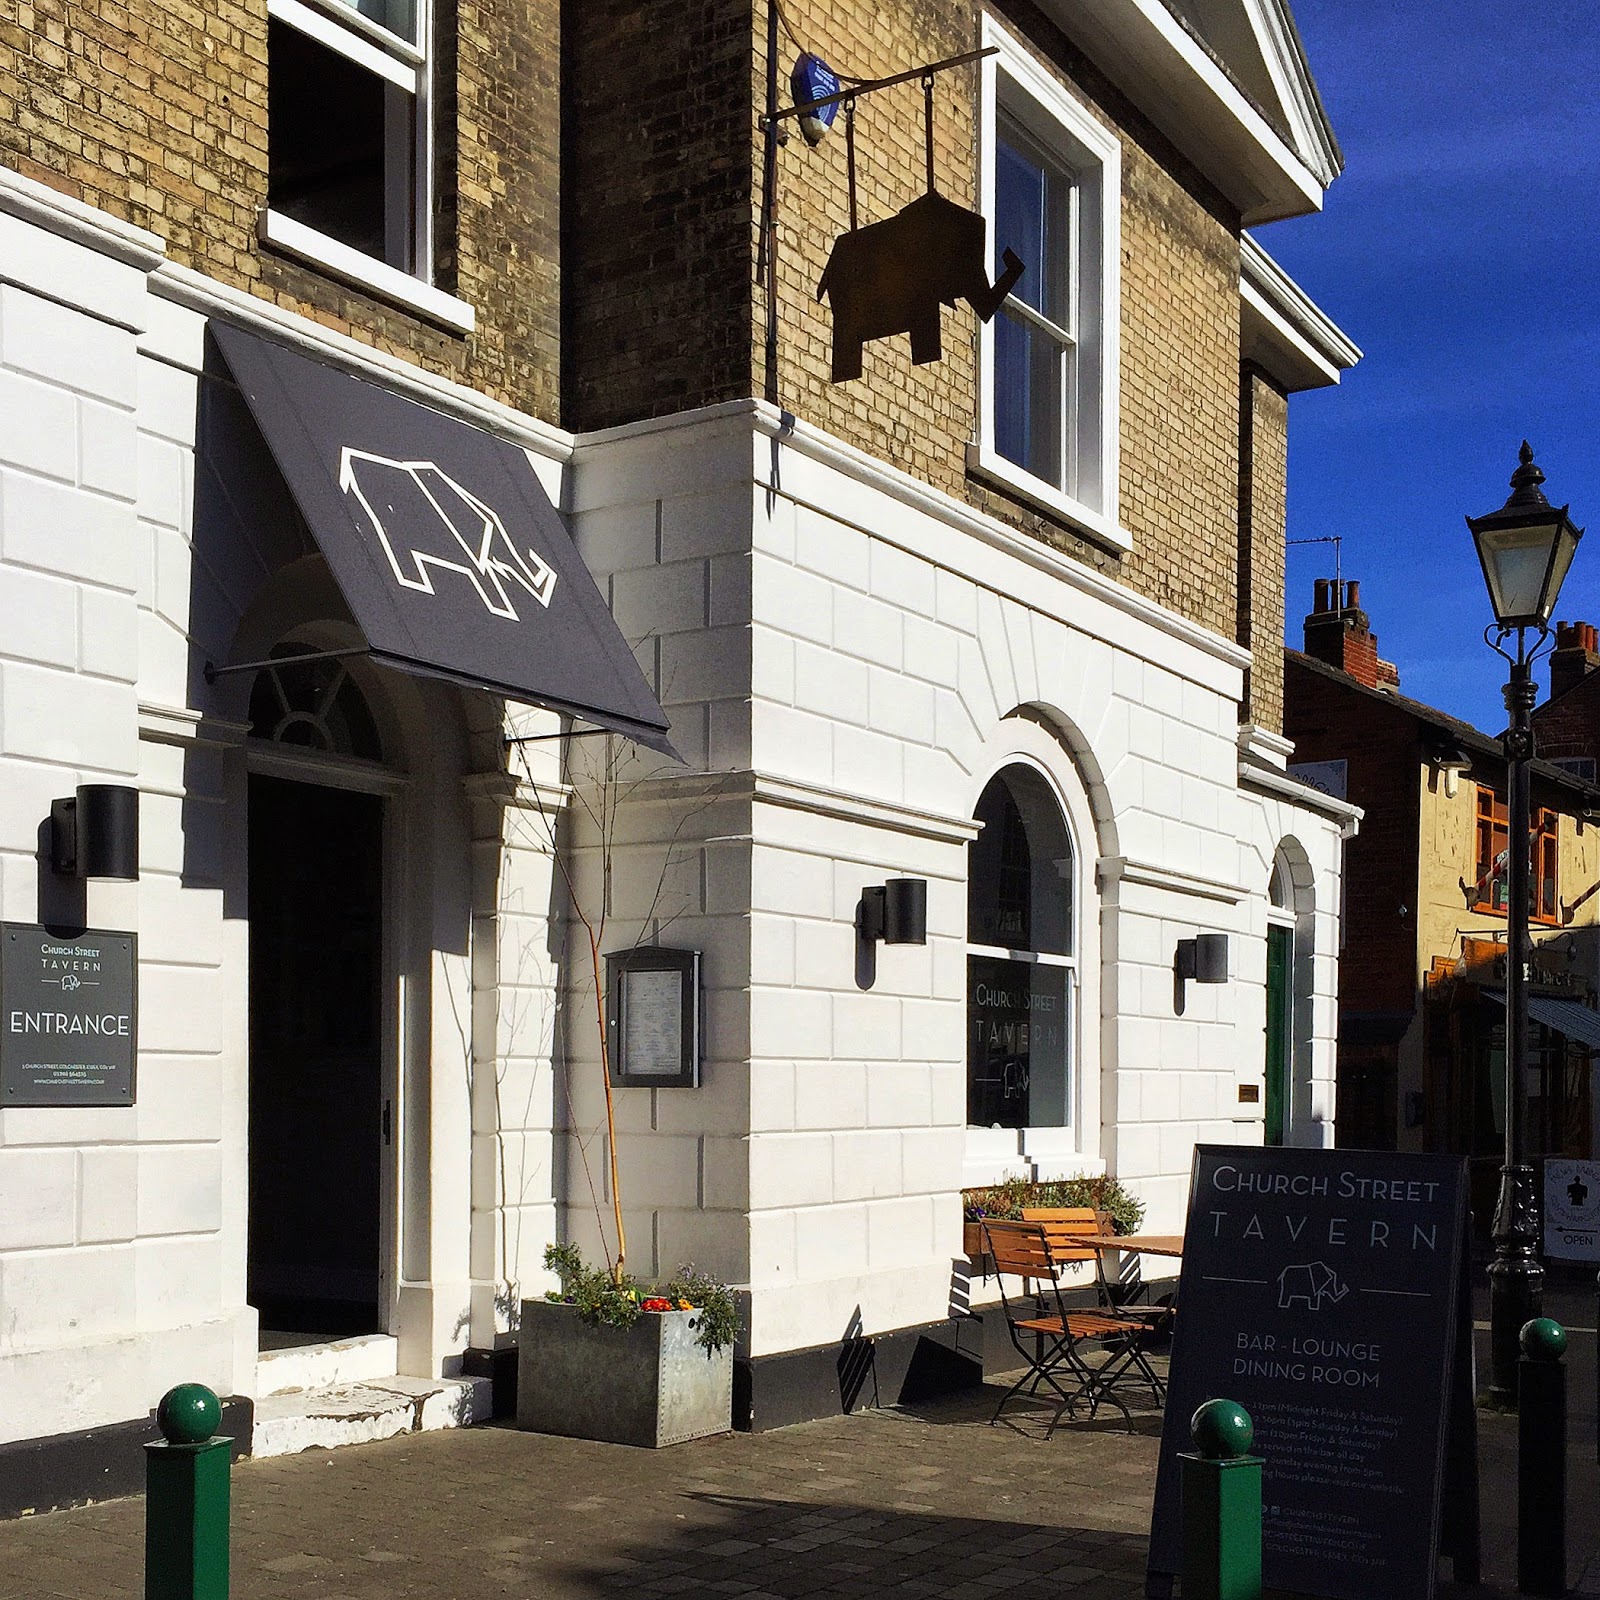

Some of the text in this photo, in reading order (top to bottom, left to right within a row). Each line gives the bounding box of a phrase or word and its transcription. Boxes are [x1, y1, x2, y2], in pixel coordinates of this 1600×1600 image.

[41, 943, 100, 958] CHURCH STREET
[41, 958, 101, 972] TAVERN
[10, 1011, 129, 1036] ENTRANCE
[975, 1019, 1057, 1046] TAVERN
[1212, 1165, 1440, 1203] CHURCH STREET
[1209, 1210, 1437, 1250] TAVERN
[1563, 1234, 1593, 1246] OPEN
[1237, 1332, 1276, 1351] BAR
[1293, 1337, 1381, 1362] LOUNGE
[1233, 1358, 1380, 1388] DINING ROOM
